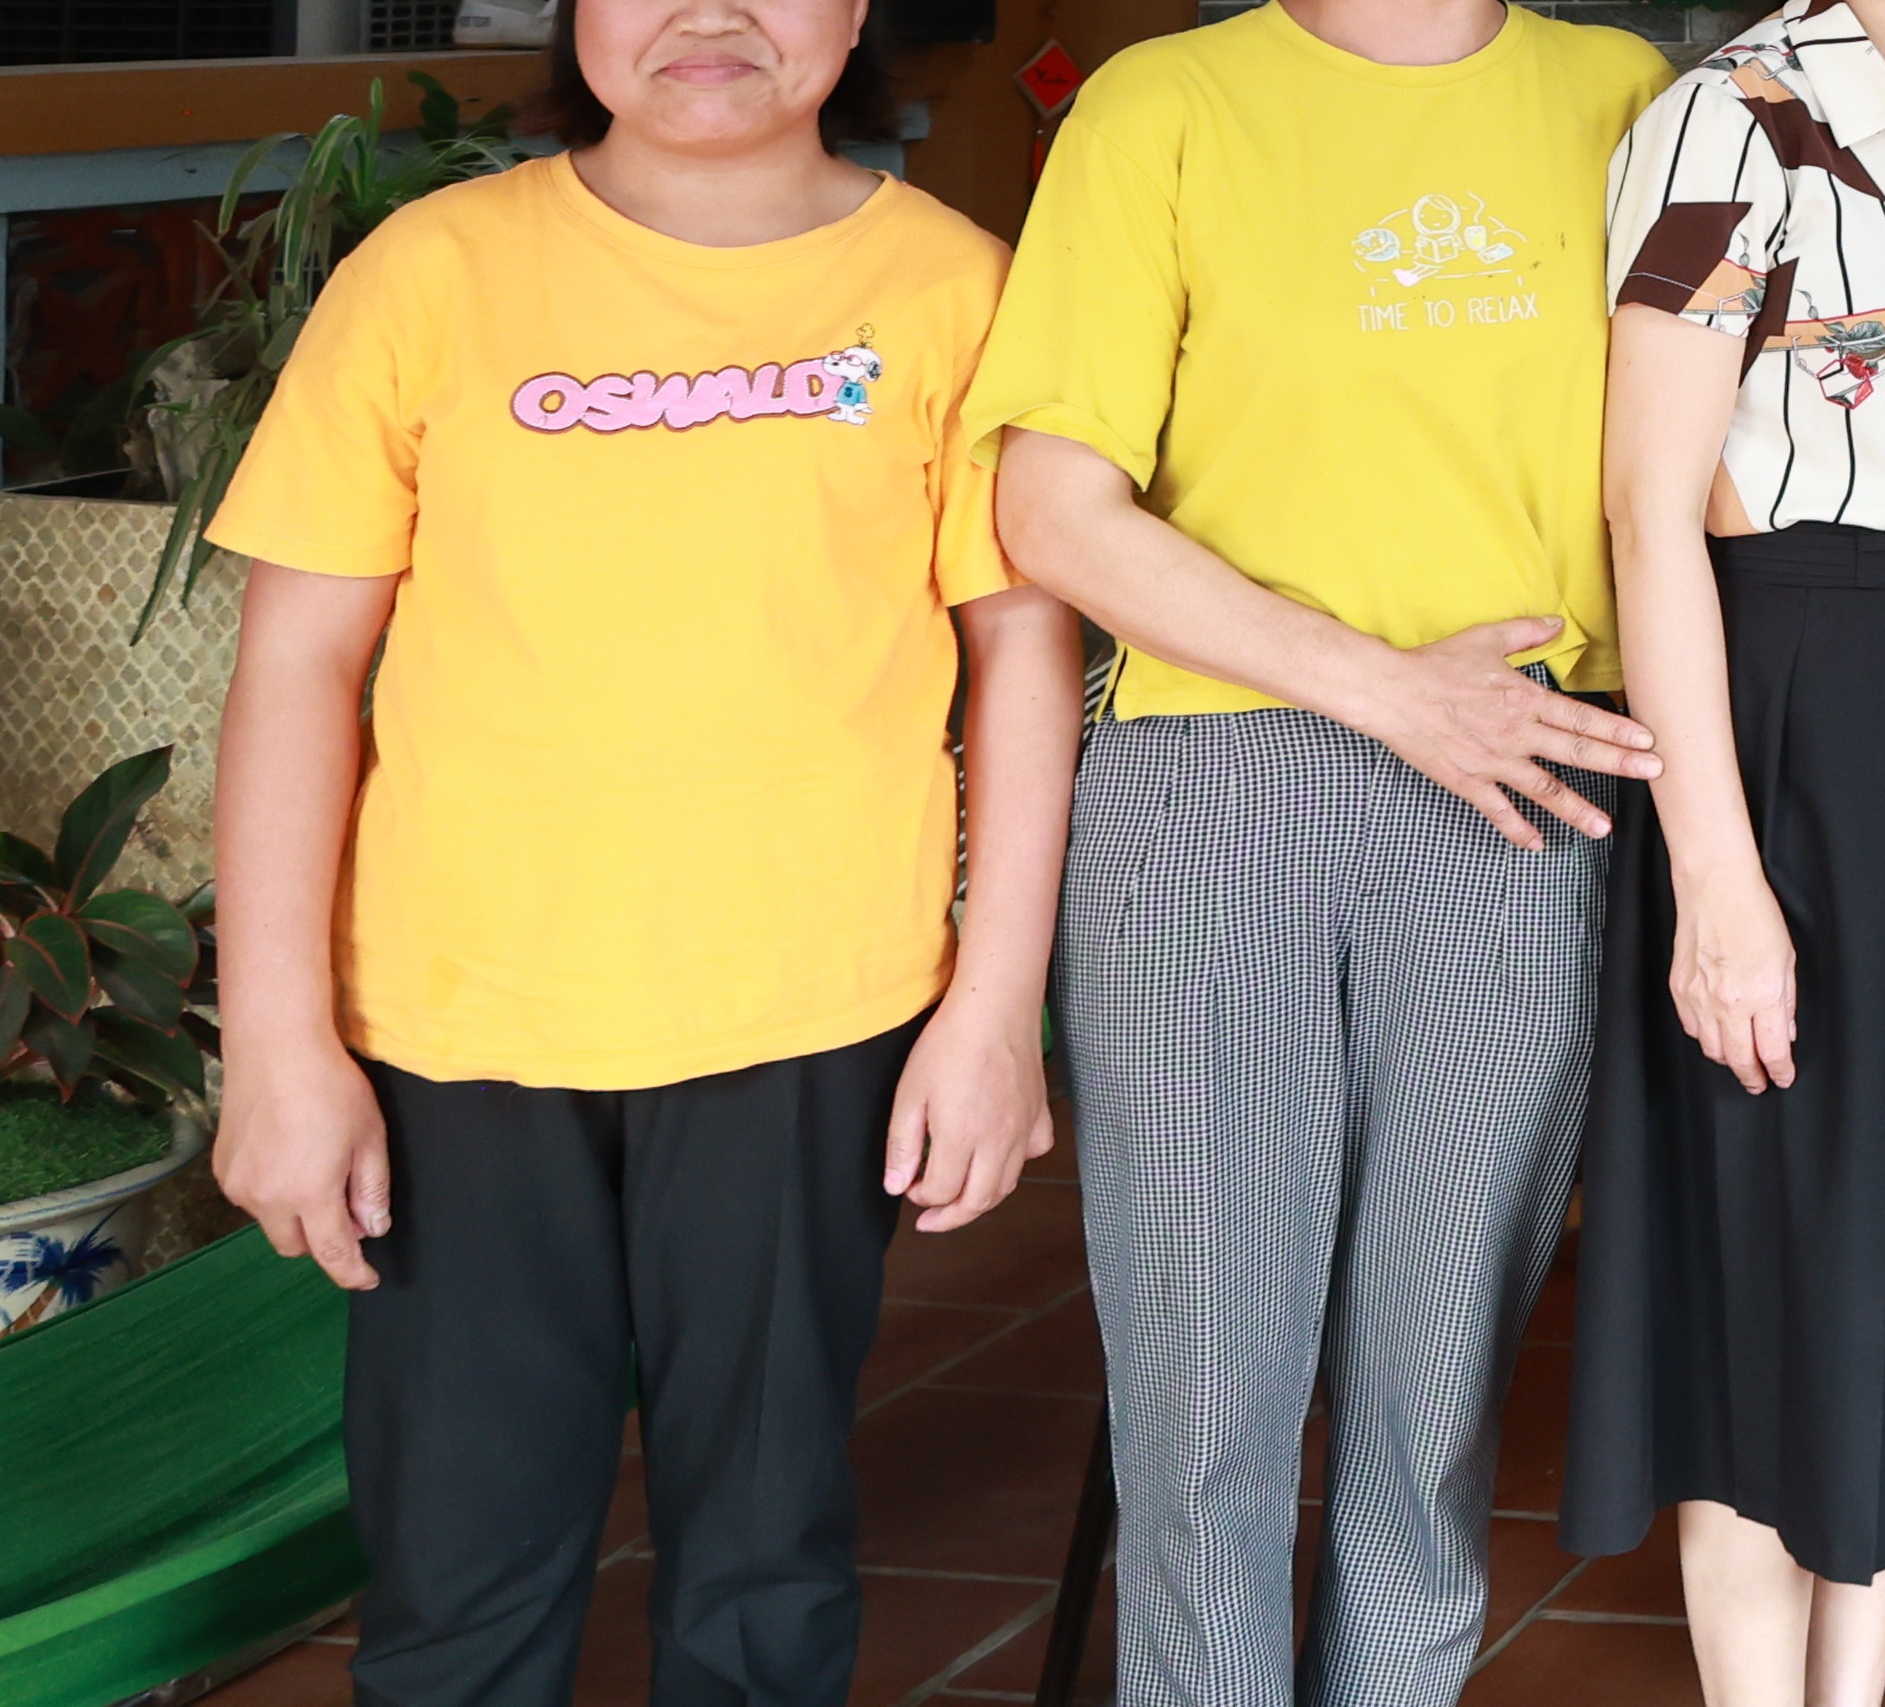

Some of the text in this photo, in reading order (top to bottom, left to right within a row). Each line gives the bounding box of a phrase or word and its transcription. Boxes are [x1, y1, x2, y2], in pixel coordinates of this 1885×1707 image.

[1357, 292, 1540, 333] TIME TO RELAX
[511, 356, 846, 435] OSWALD
